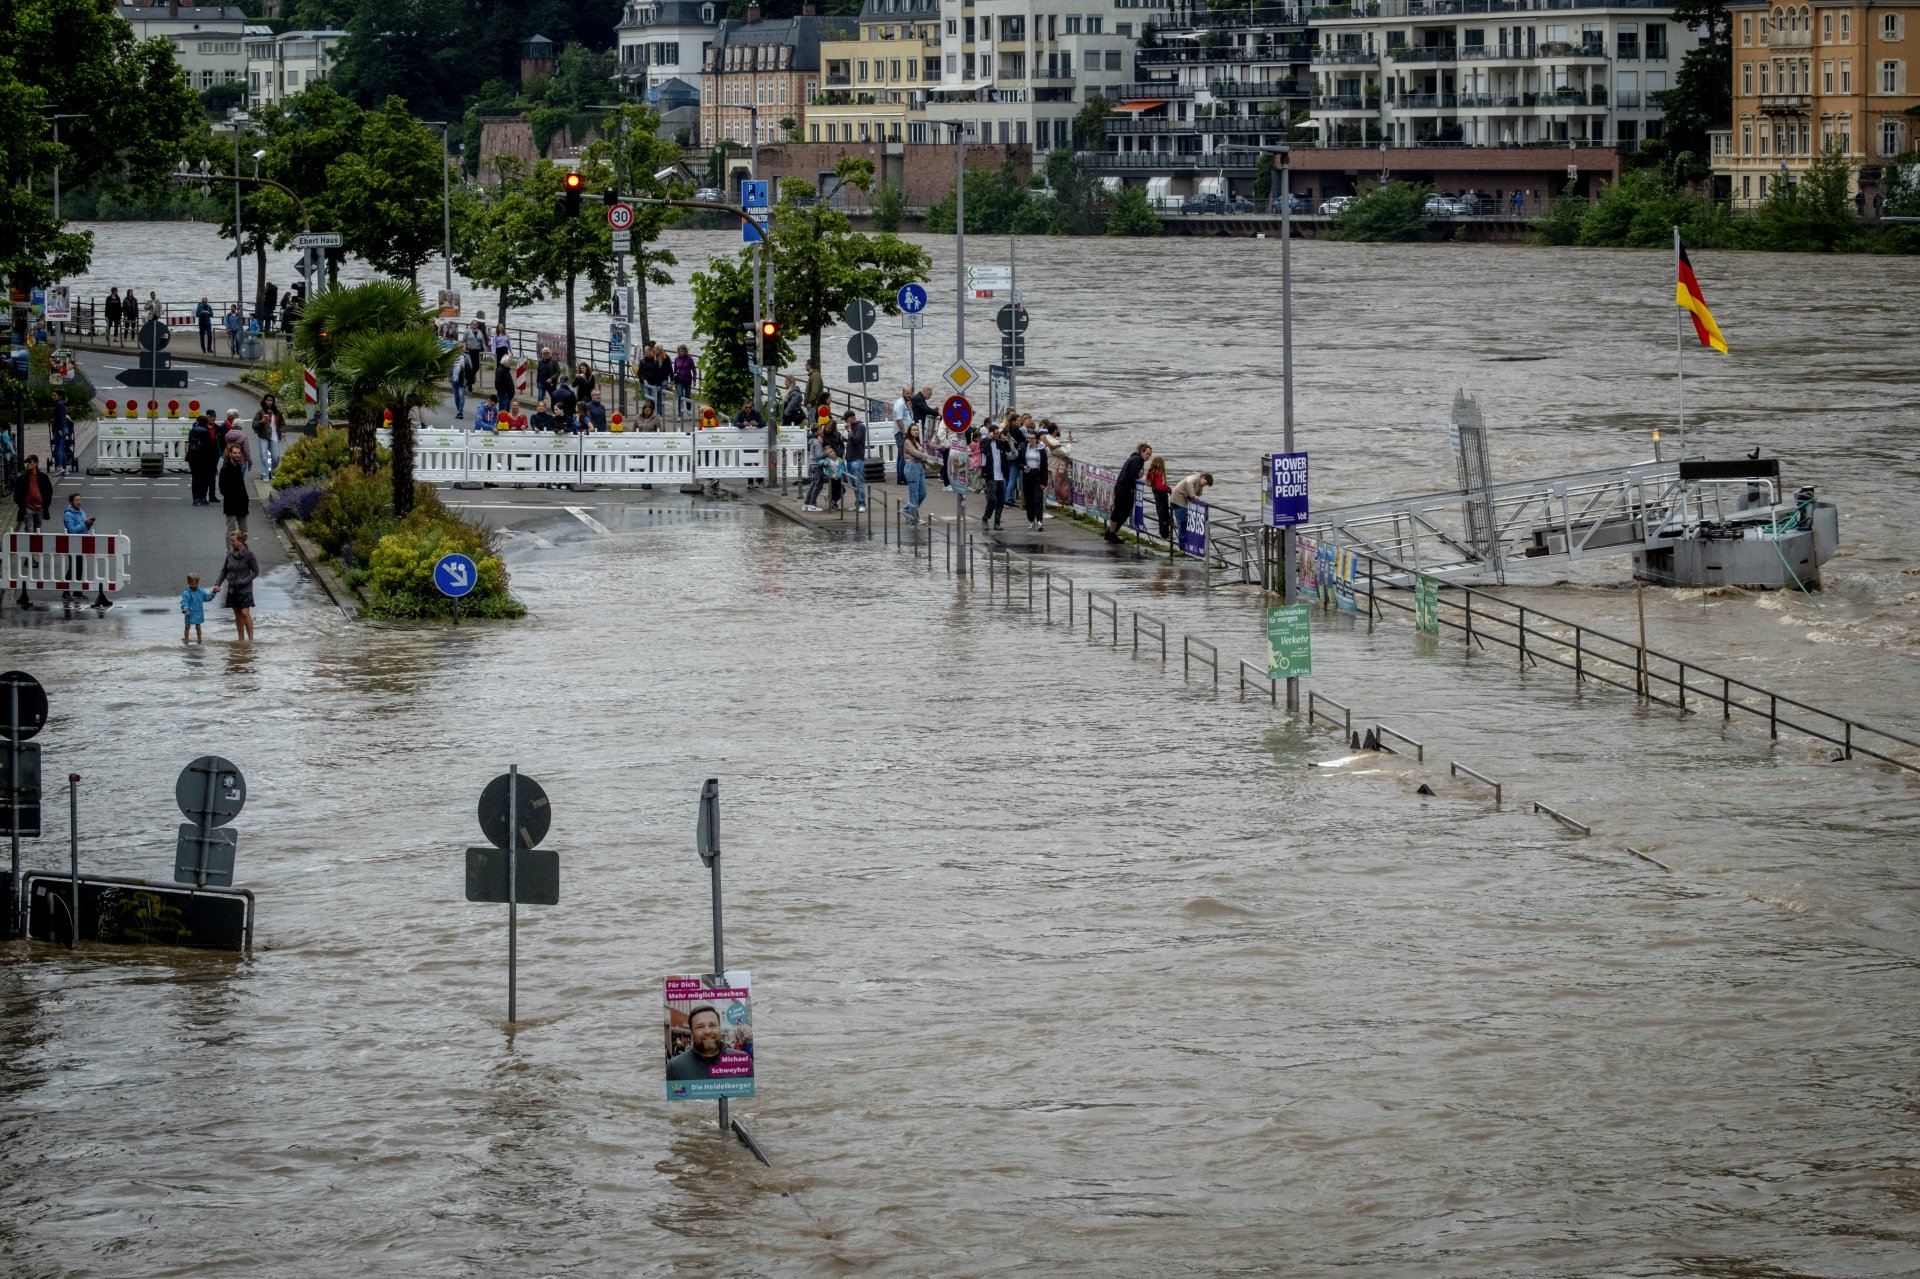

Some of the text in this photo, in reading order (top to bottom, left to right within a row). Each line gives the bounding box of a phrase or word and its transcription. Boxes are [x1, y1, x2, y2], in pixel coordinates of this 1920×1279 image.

[614, 211, 628, 222] 30
[299, 236, 338, 245] Ebert Haus
[1275, 457, 1306, 471] POWER
[1275, 470, 1306, 484] TO THE
[1275, 484, 1306, 497] PEOPLE
[1297, 512, 1307, 520] Volt
[1281, 635, 1309, 645] Verkehr
[687, 991, 716, 1000] möglich
[705, 1082, 751, 1090] Heidelberger
